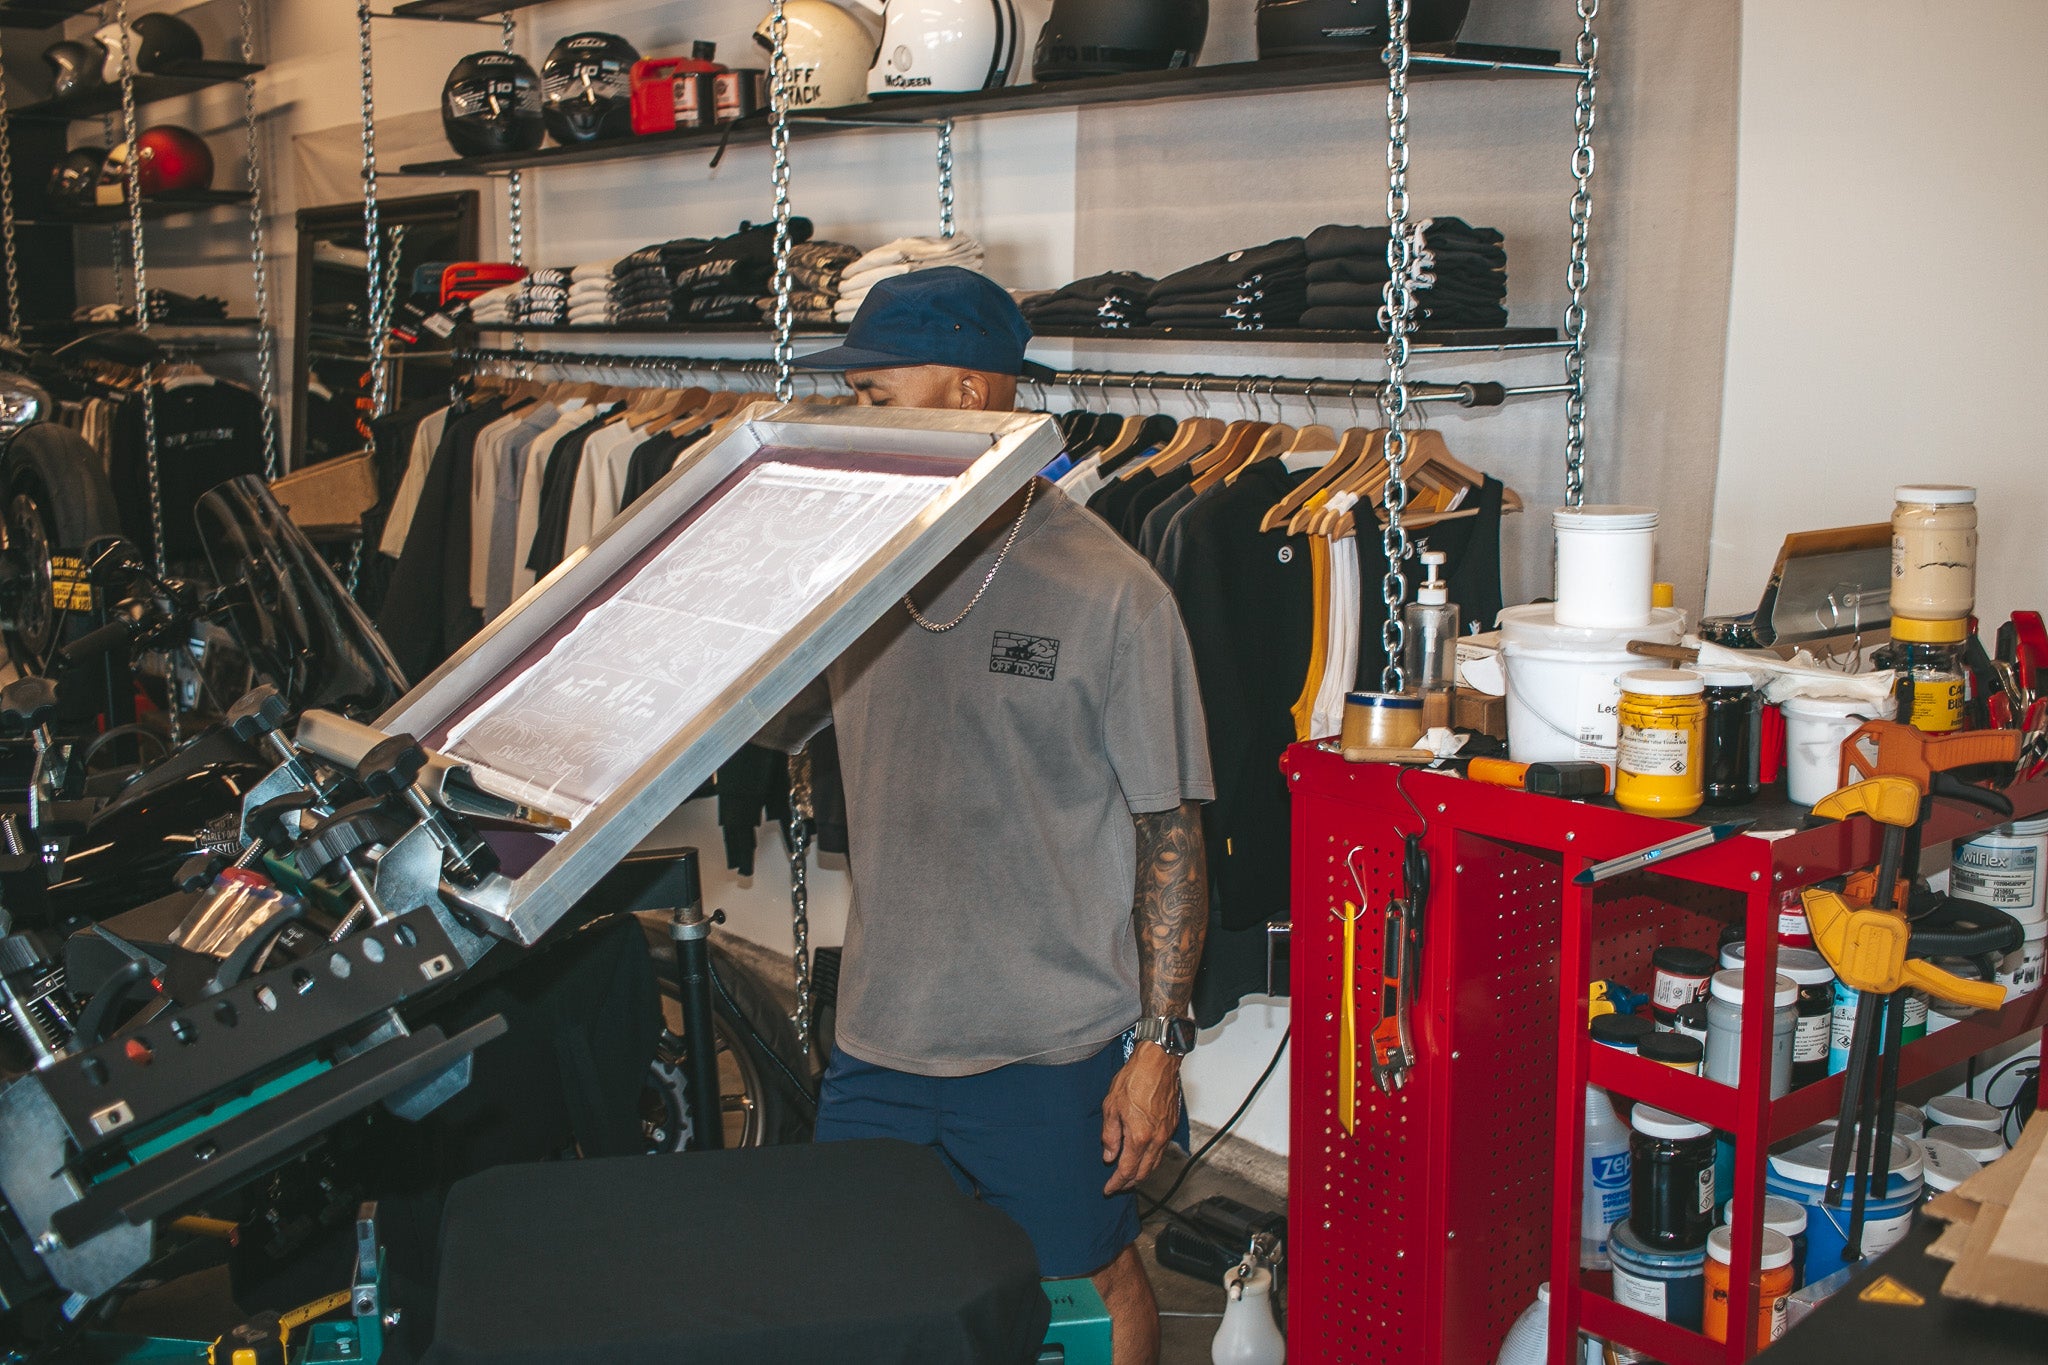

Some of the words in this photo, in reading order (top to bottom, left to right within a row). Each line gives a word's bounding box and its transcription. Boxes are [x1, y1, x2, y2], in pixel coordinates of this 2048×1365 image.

[783, 68, 815, 83] OFF
[885, 75, 932, 88] McQUEEN
[990, 659, 1013, 672] OFF
[1013, 662, 1054, 679] TRACK
[1963, 851, 2008, 868] wilflex
